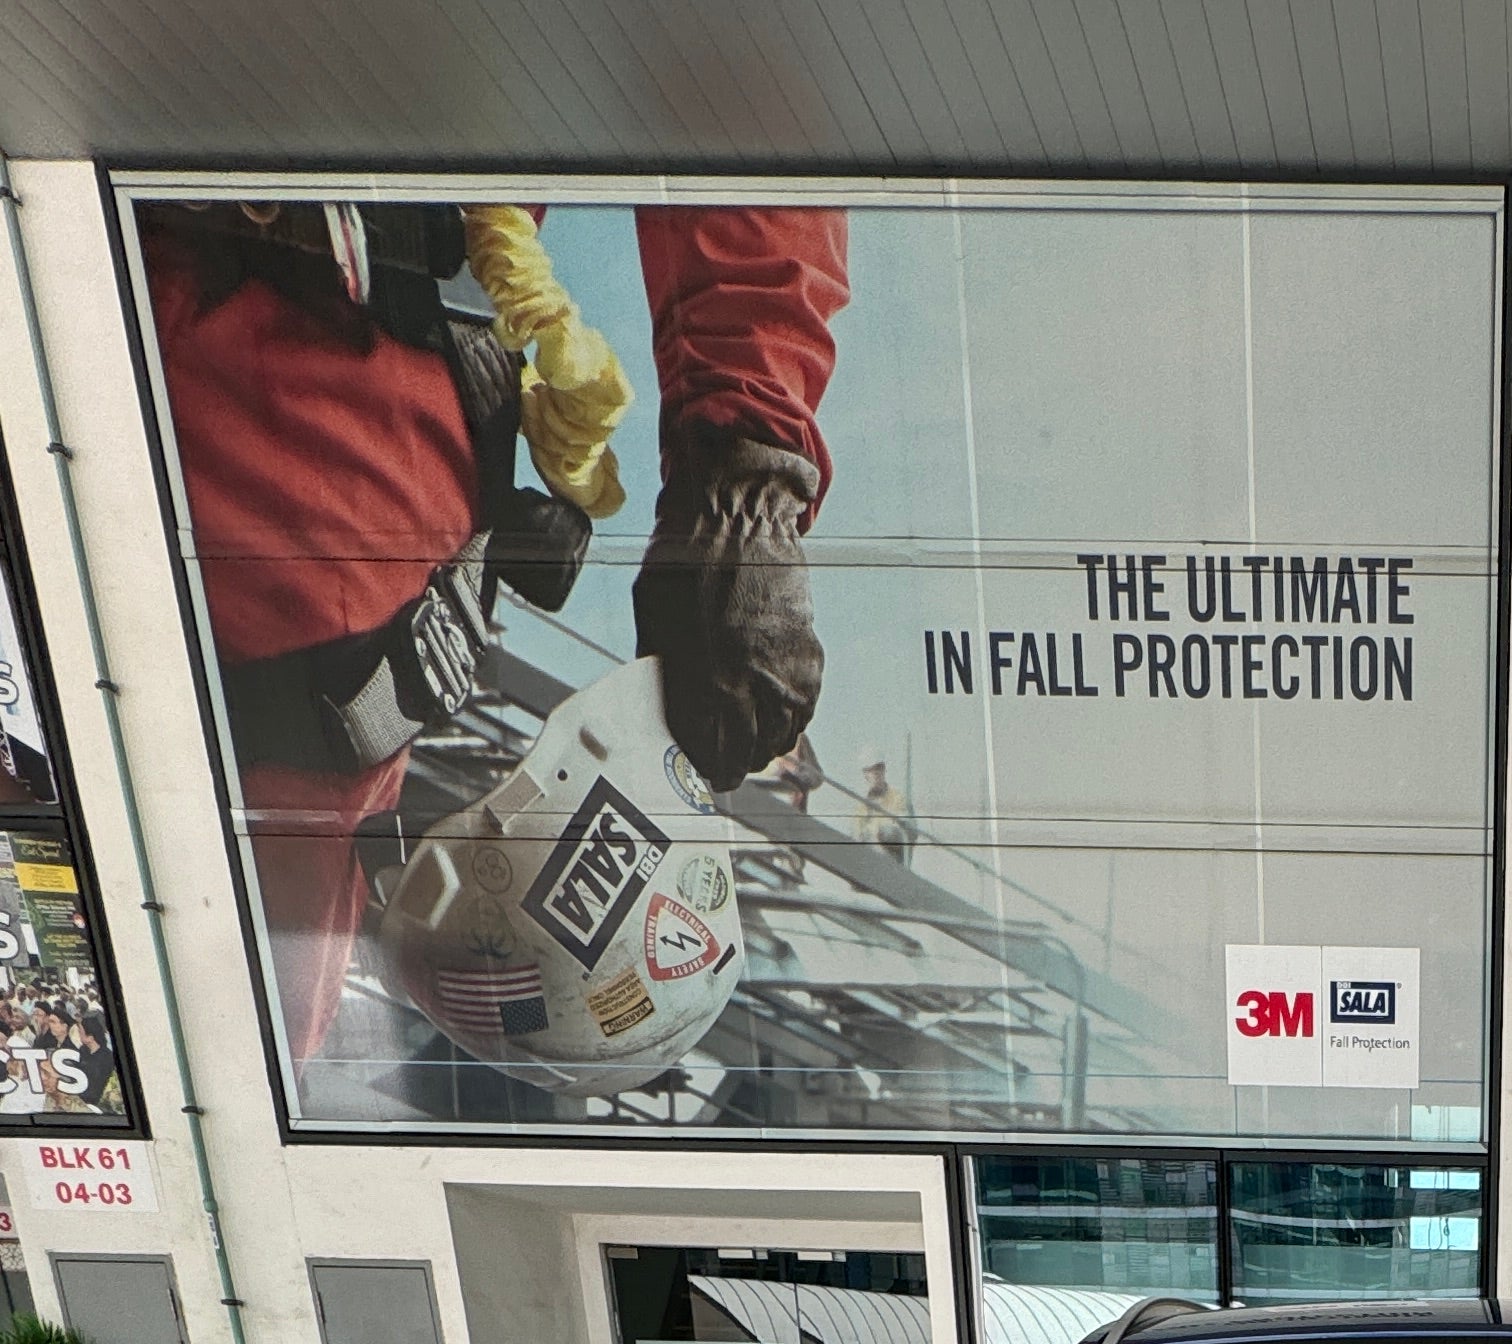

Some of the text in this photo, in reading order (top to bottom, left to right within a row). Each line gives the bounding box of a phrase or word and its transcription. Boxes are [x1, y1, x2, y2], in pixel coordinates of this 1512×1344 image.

[1077, 554, 1415, 624] THE ULTIMATE
[924, 630, 1413, 701] IN FALL PROTECTION
[551, 812, 637, 934] SALA
[1235, 990, 1314, 1038] 3M
[1340, 991, 1387, 1014] SALA
[607, 1003, 648, 1029] WARNING
[1330, 1036, 1411, 1050] Fall Protection
[39, 1146, 131, 1170] BLK 61
[55, 1181, 132, 1205] 04-03
